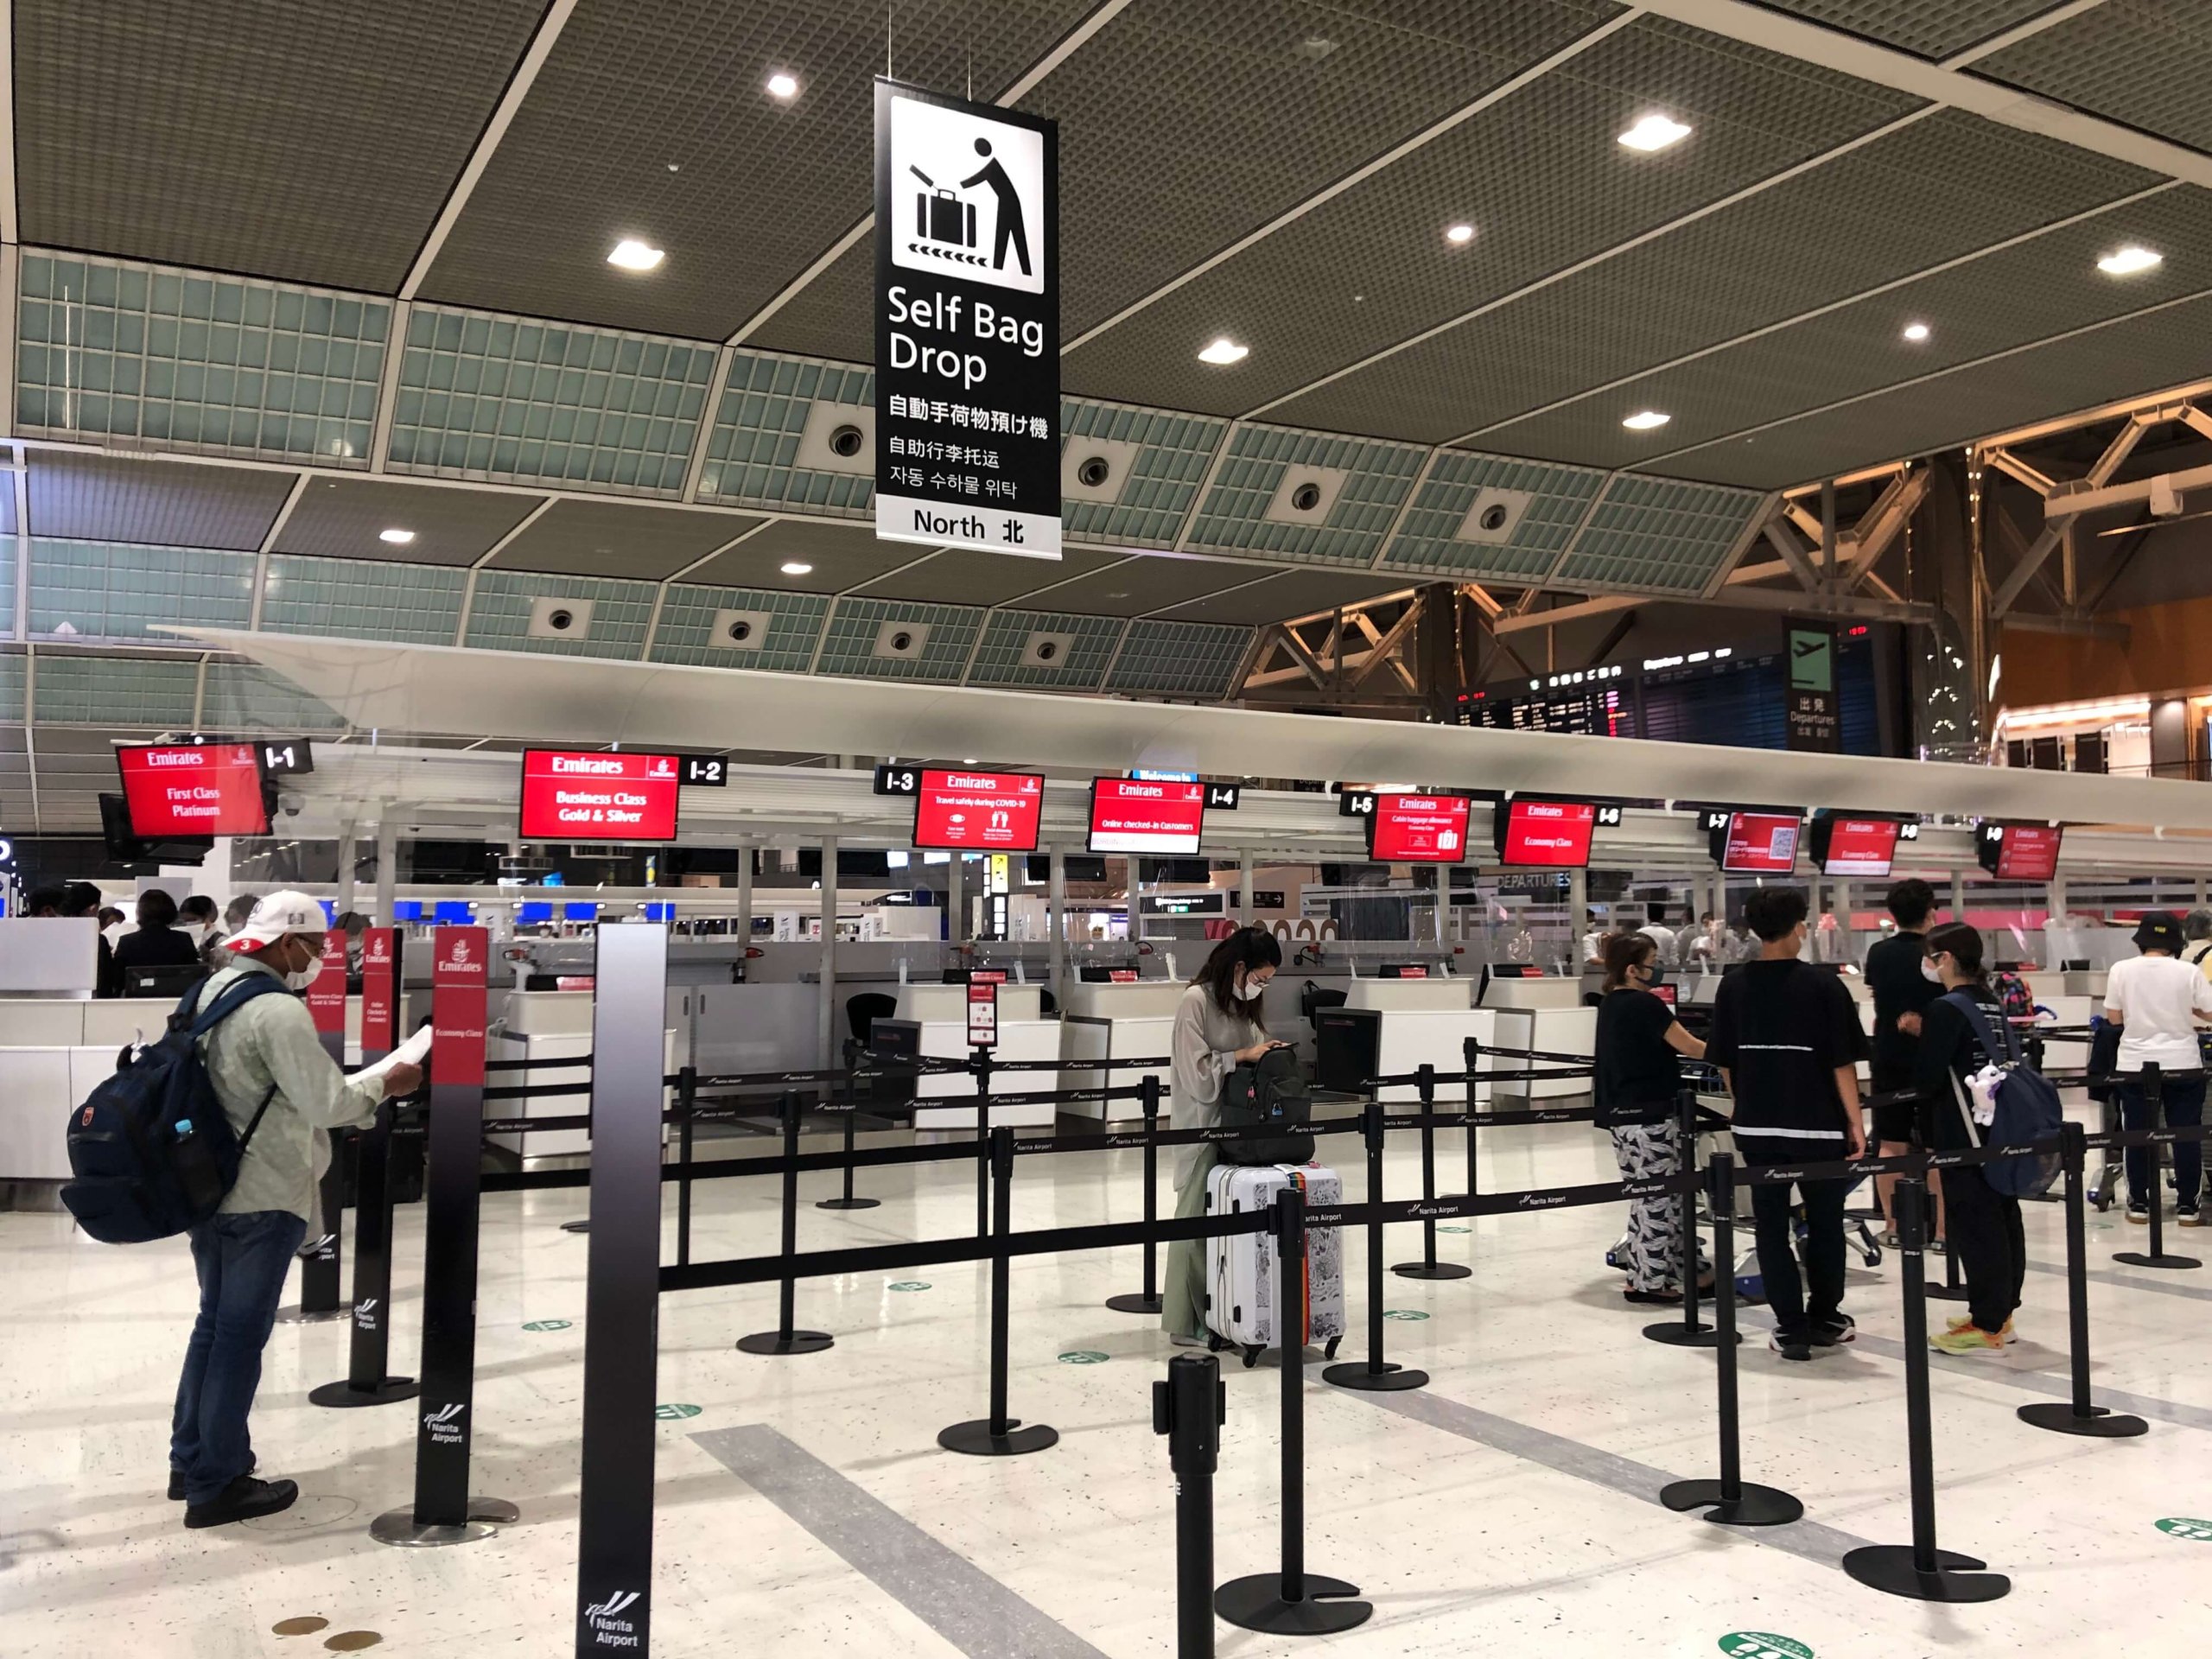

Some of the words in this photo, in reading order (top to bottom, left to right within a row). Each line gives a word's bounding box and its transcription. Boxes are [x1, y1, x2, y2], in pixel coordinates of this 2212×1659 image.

[888, 286, 962, 333] Self
[975, 302, 1043, 357] Bag
[891, 332, 987, 390] Drop
[889, 394, 1048, 440] 自動手荷物預け機
[890, 435, 1000, 468] 自助行李托运
[890, 466, 925, 487] 자동
[930, 472, 980, 495] 수하물
[985, 479, 1018, 499] 위탁
[914, 509, 985, 539] North
[1002, 519, 1024, 543] 北
[1790, 711, 1835, 725] Departures
[147, 751, 204, 766] Emirates
[265, 747, 295, 768] I-1
[552, 757, 624, 774] Emirates
[690, 760, 721, 780] I-2
[887, 772, 913, 791] I-3
[947, 775, 996, 789] Emirates
[167, 787, 192, 800] First
[194, 787, 220, 799] Class
[1119, 784, 1162, 797] Emirates
[1211, 788, 1233, 804] I-4
[556, 791, 611, 805] Business
[613, 793, 647, 806] Class
[936, 796, 955, 804] Travel
[956, 797, 974, 807] safely
[975, 798, 995, 808] during
[995, 799, 1027, 808] COVID-19
[1351, 797, 1372, 813] I-5
[1399, 798, 1437, 810] Emirates
[172, 804, 220, 817] Platinum
[558, 809, 590, 822] Gold
[592, 810, 603, 822] &
[607, 810, 642, 823] Silver
[1528, 805, 1563, 817] Emirates
[1103, 819, 1122, 828] Online
[1123, 820, 1159, 830] checked-in
[1160, 822, 1193, 830] Customers
[1524, 836, 1555, 848] Economy
[1556, 838, 1573, 847] Class
[1497, 873, 1571, 888] DEPARTURES
[240, 940, 250, 950] 3
[438, 961, 482, 972] Emirates
[435, 1029, 464, 1038] Economy
[1647, 1184, 1665, 1192] Airport
[1548, 1196, 1566, 1205] Airport
[1439, 1205, 1459, 1214] Airport
[1320, 1213, 1341, 1222] Airport
[358, 1313, 374, 1322] Narita
[358, 1321, 376, 1330] Airport
[432, 1423, 459, 1434] Narita
[432, 1433, 463, 1444] Airport
[596, 1618, 633, 1632] Narita
[596, 1631, 638, 1647] Airport
